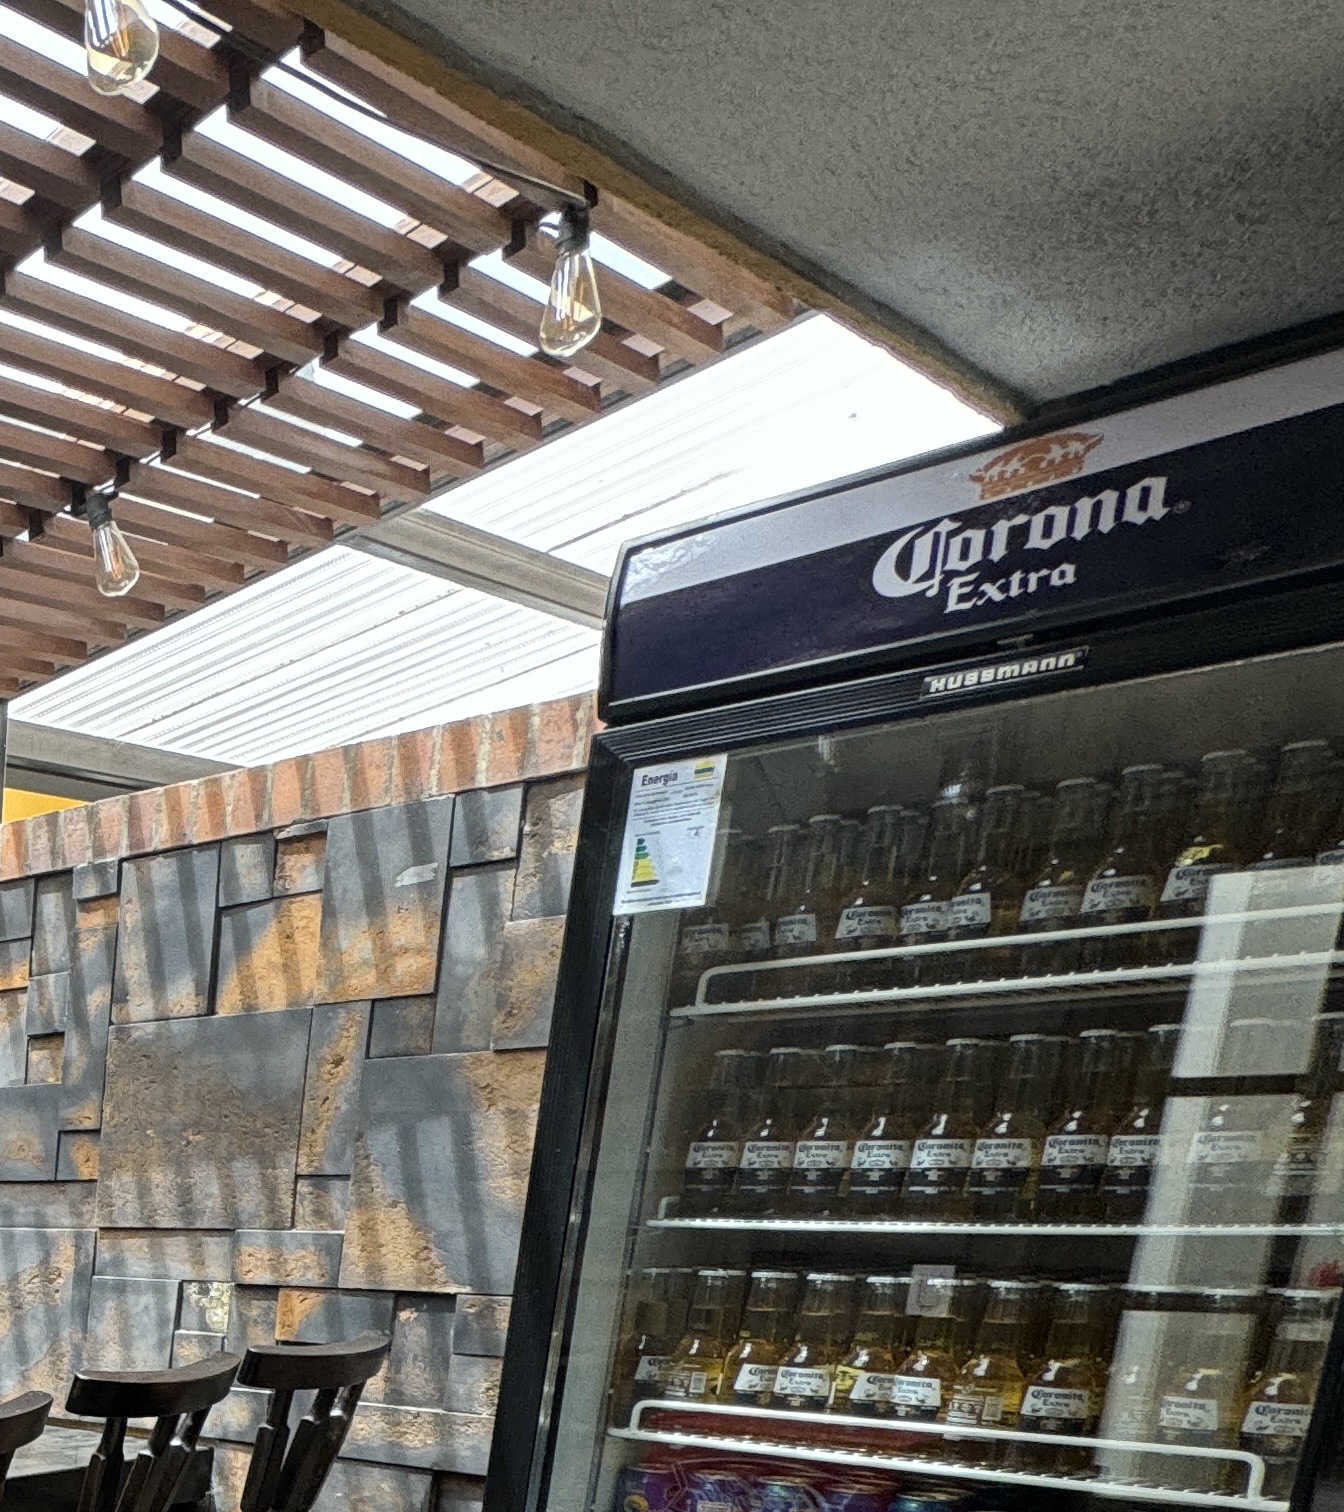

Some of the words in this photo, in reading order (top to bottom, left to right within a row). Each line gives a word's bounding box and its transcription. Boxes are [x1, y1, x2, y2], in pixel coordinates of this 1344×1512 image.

[872, 476, 1170, 598] Corona
[943, 563, 1077, 614] Extra
[929, 653, 1076, 693] HUSSMANN
